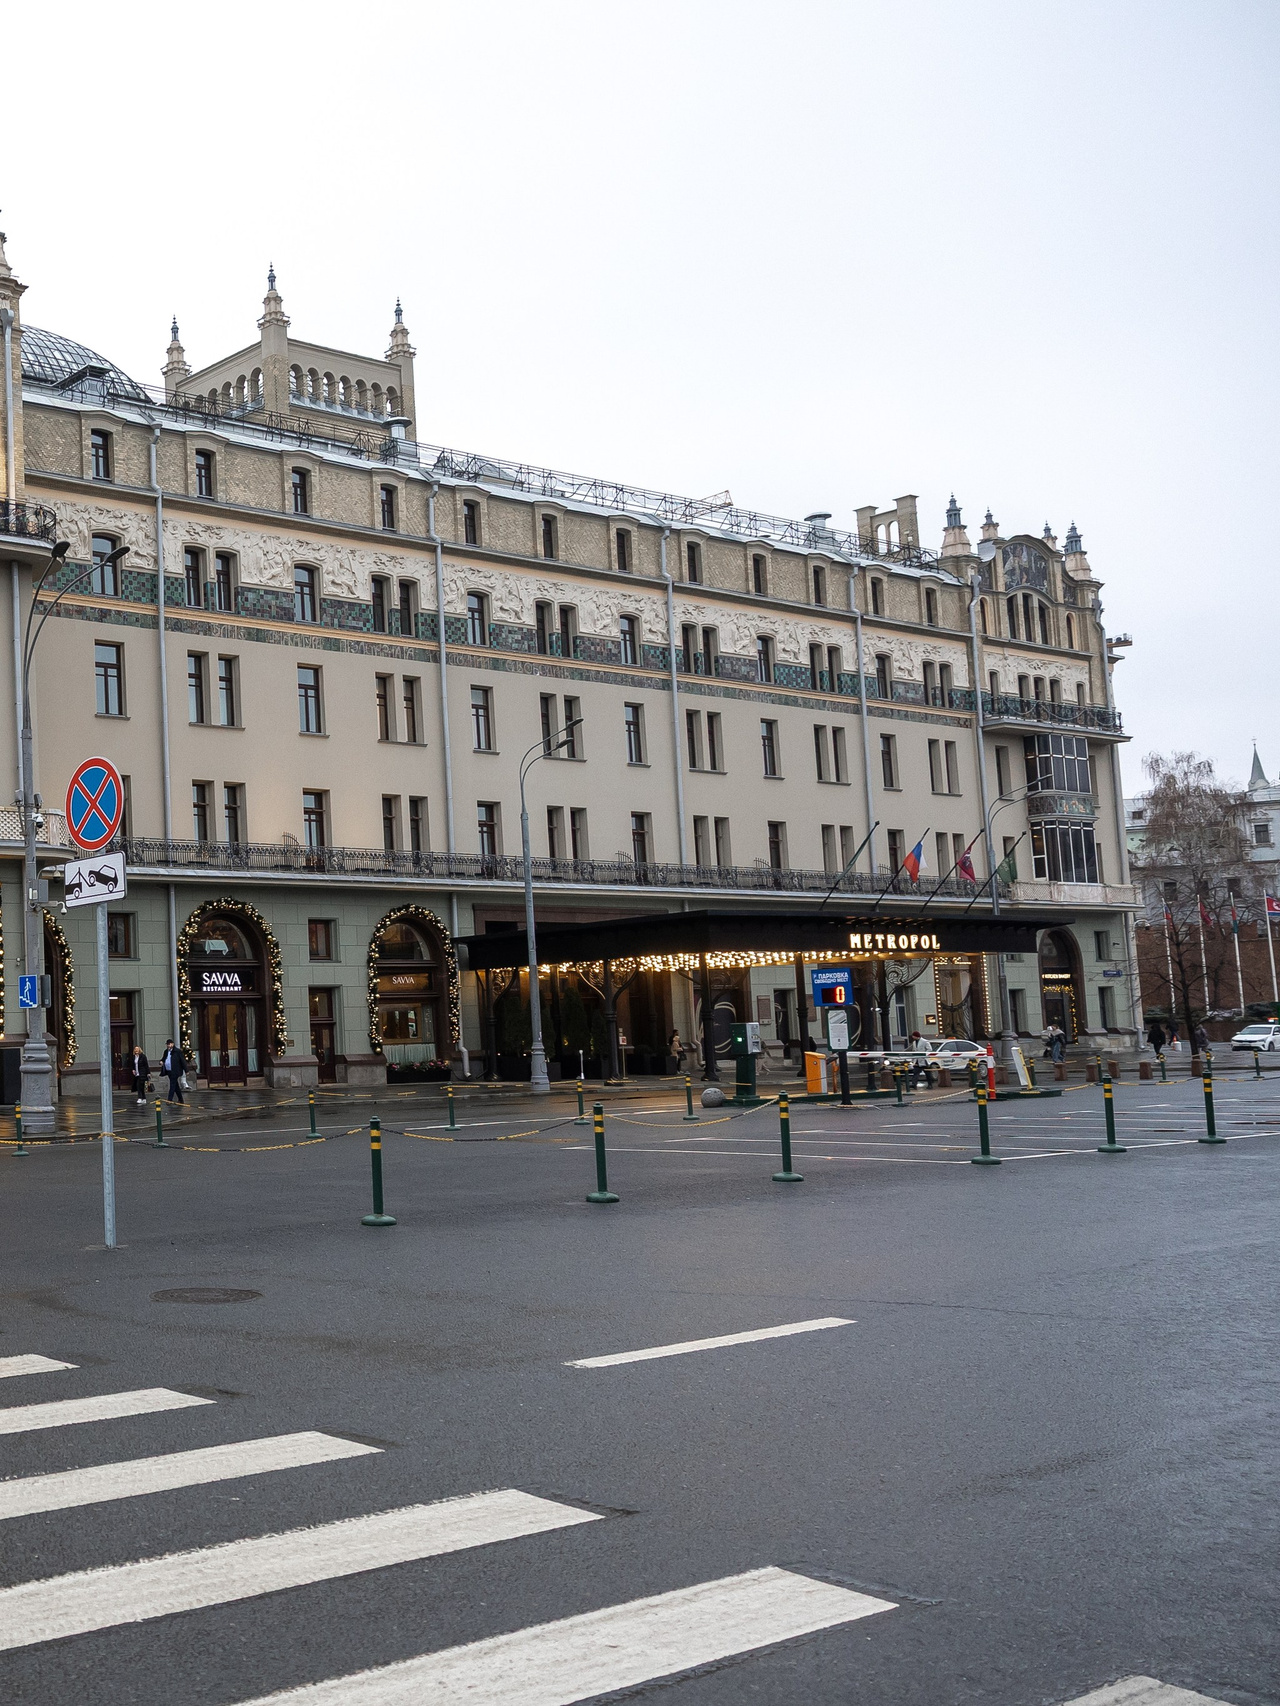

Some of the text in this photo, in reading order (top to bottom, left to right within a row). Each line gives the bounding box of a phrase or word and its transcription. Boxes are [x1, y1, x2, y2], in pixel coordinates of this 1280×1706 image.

[849, 933, 941, 949] METROPOL
[202, 972, 241, 985] SAVVA
[392, 976, 415, 985] SAVVA
[836, 986, 845, 1003] 0
